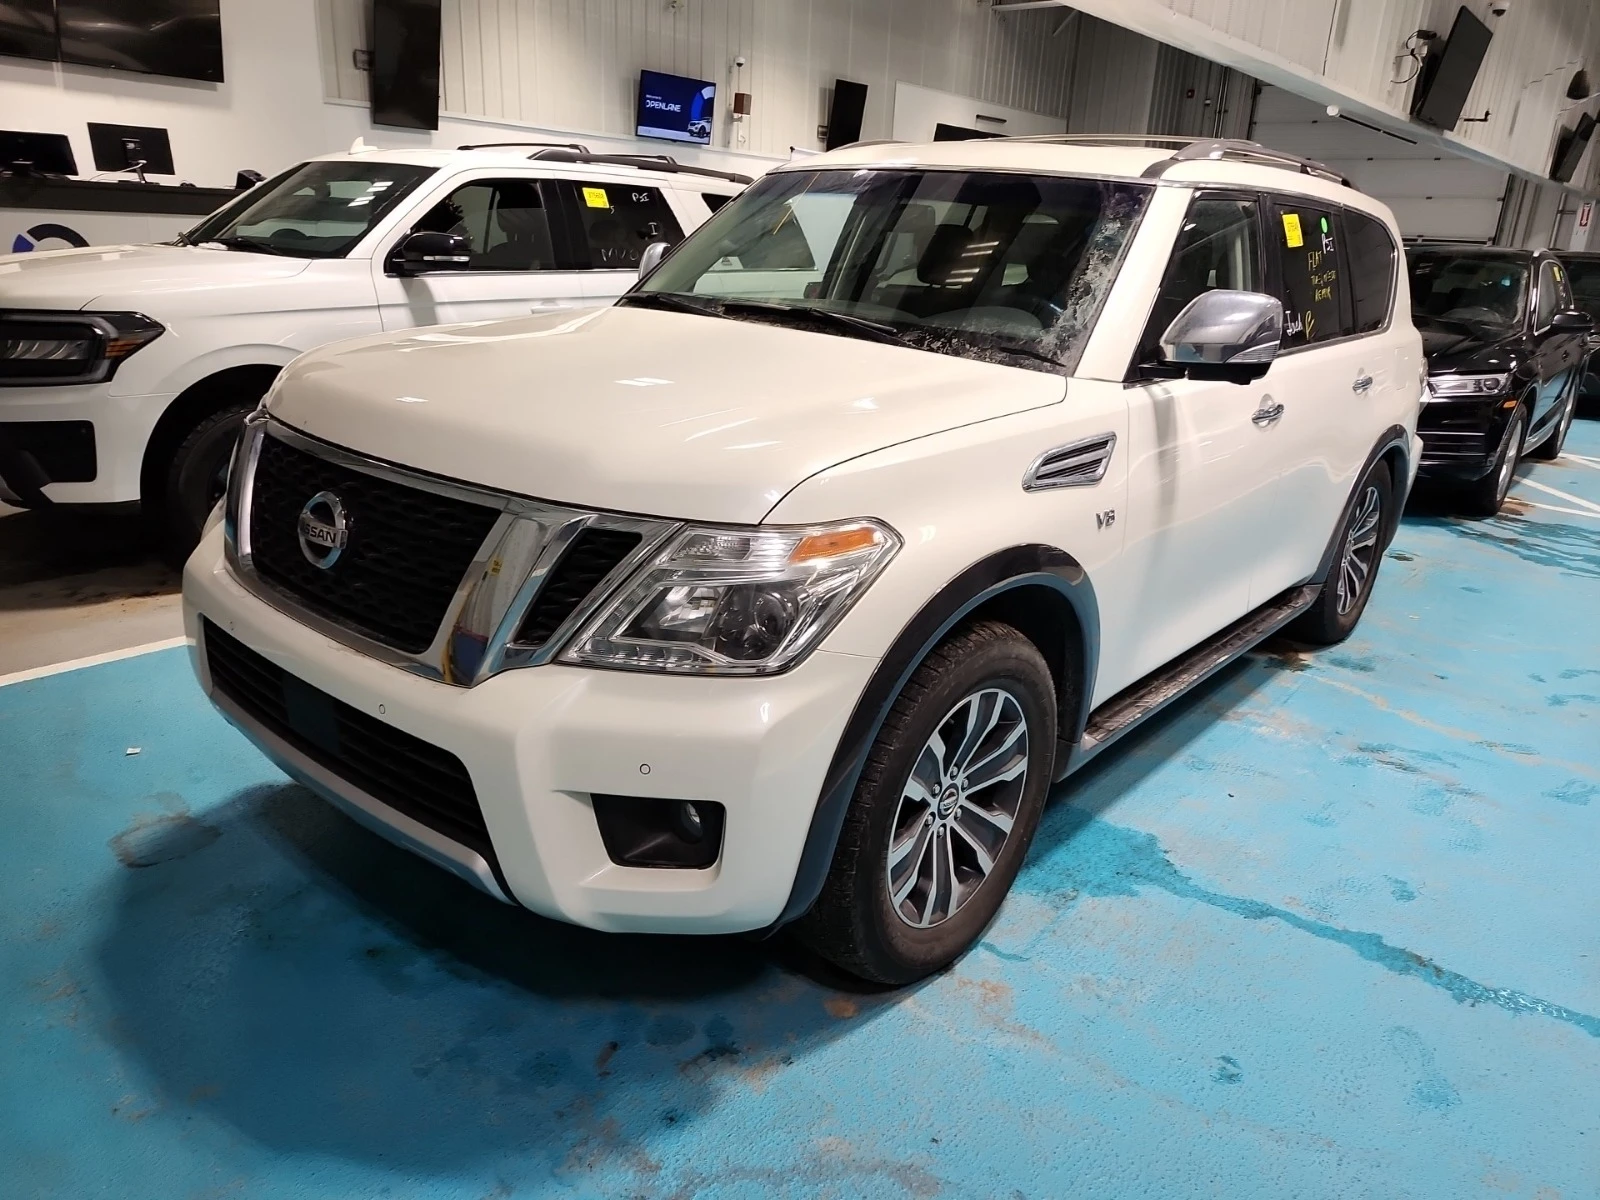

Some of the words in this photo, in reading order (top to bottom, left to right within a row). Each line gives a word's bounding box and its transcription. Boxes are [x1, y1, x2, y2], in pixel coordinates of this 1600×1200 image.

[646, 99, 682, 113] OPENLANE
[1308, 250, 1323, 271] FLAT
[1095, 509, 1115, 530] V8
